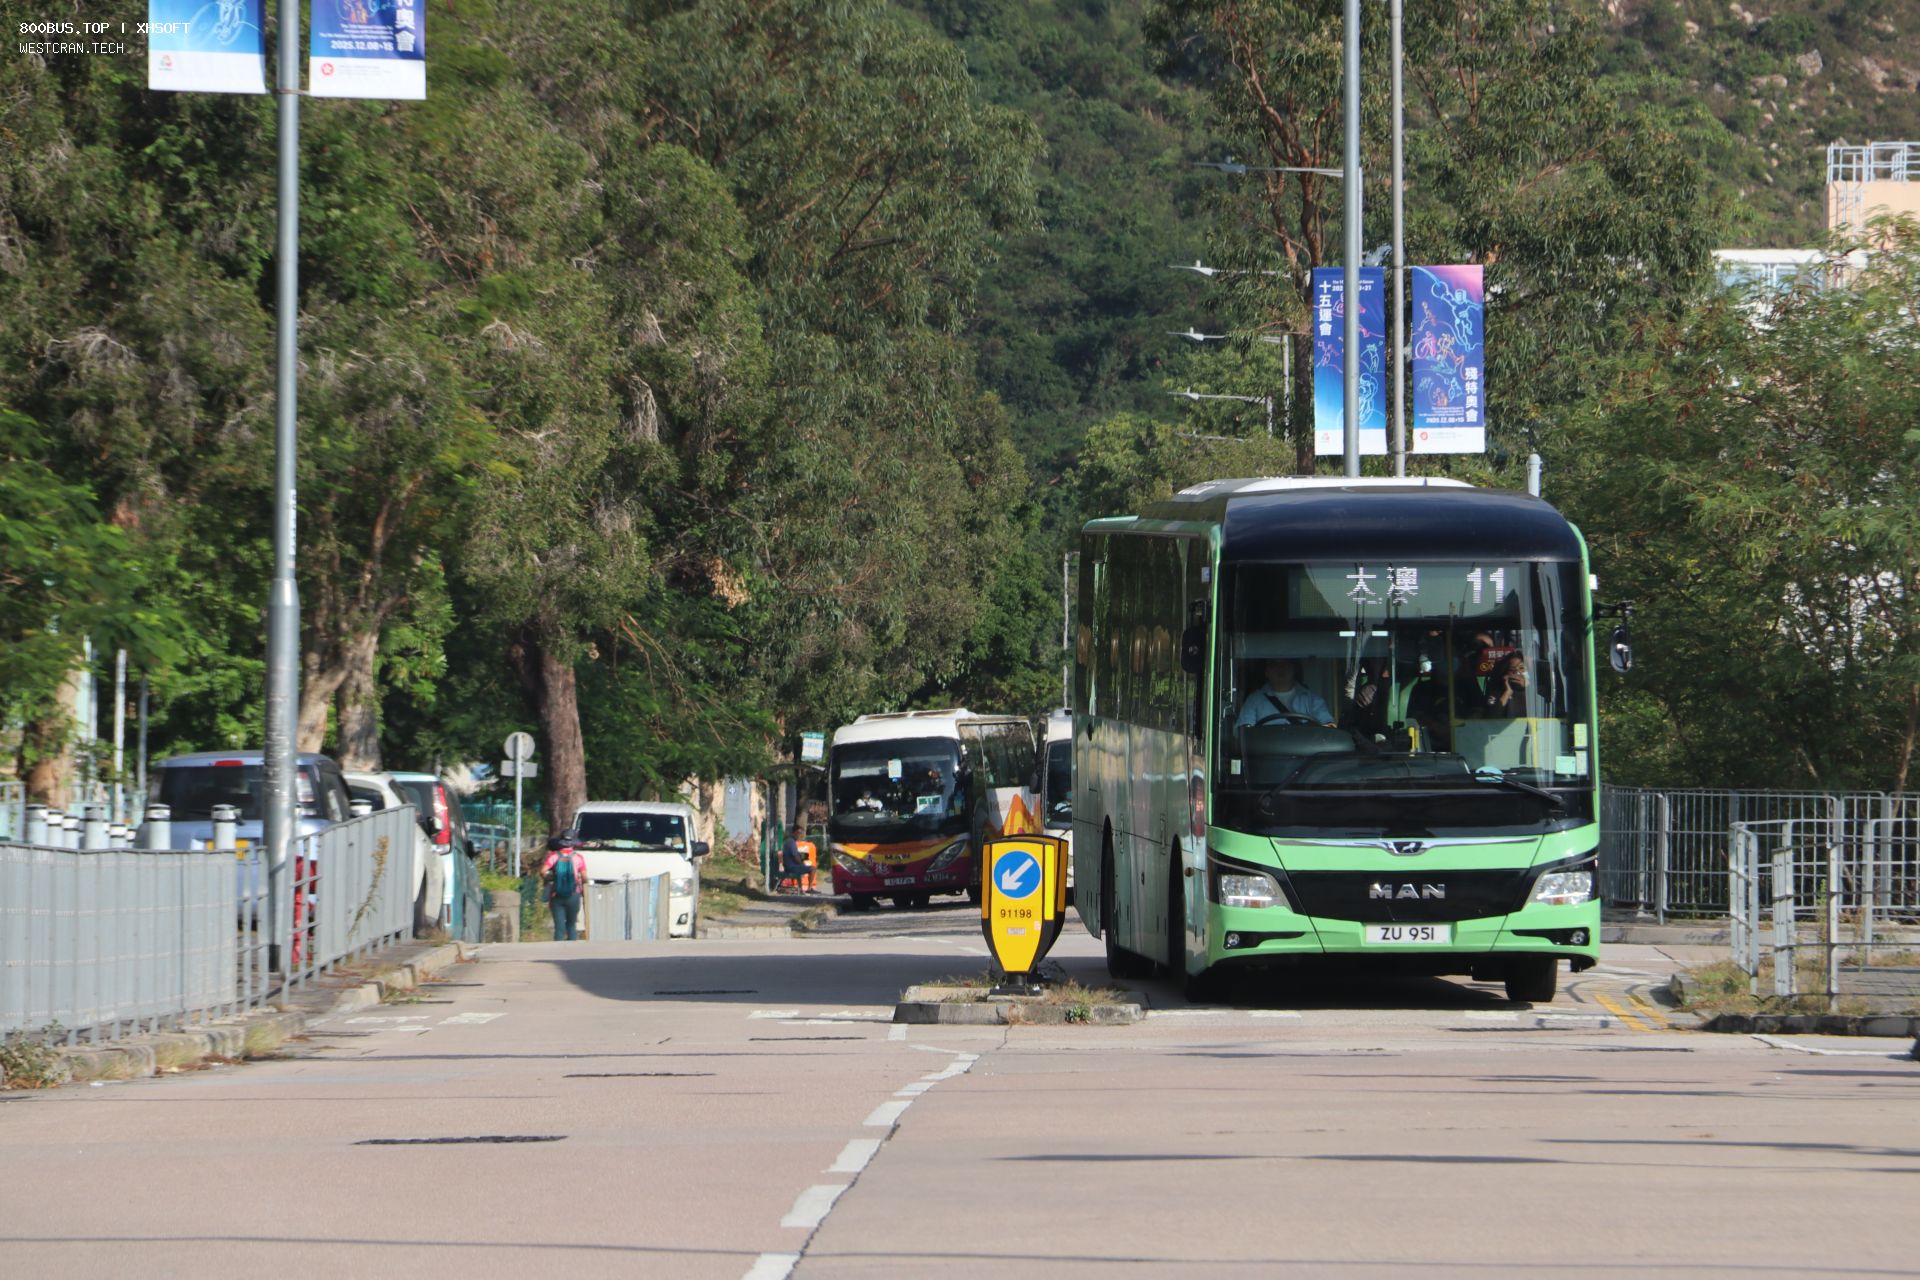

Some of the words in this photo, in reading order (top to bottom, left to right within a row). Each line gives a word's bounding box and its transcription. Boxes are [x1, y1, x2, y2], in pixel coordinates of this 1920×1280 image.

[1318, 280, 1333, 336] 十五運會
[1465, 367, 1478, 423] 殘特奧會
[1346, 566, 1420, 597] 大澳
[1466, 567, 1505, 604] 11
[1369, 883, 1446, 899] MAN
[1000, 908, 1032, 919] 91198
[1380, 927, 1402, 941] ZU
[1409, 927, 1434, 941] 951
